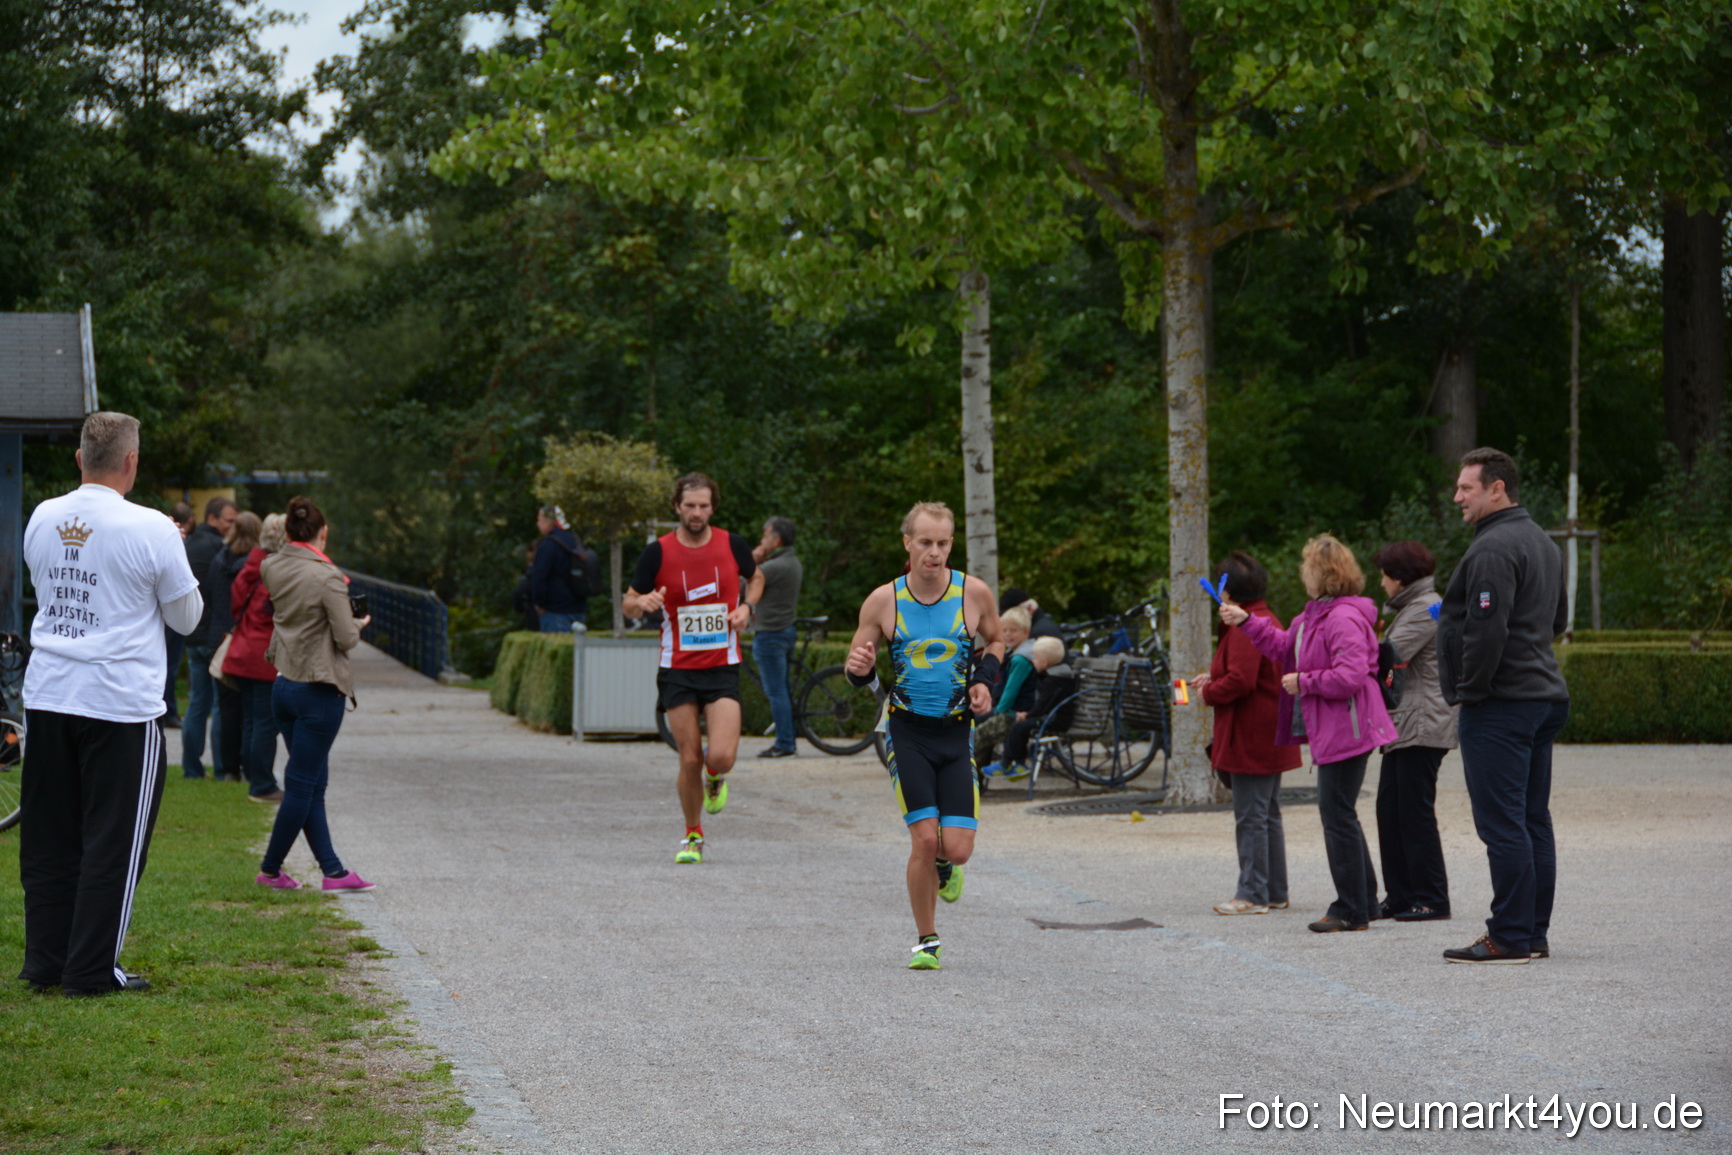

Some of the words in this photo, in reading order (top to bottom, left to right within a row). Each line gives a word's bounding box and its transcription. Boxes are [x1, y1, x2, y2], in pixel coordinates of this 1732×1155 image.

[65, 548, 79, 561] IM
[53, 587, 89, 604] EINER
[52, 624, 85, 639] JESUS
[684, 615, 724, 632] 2186
